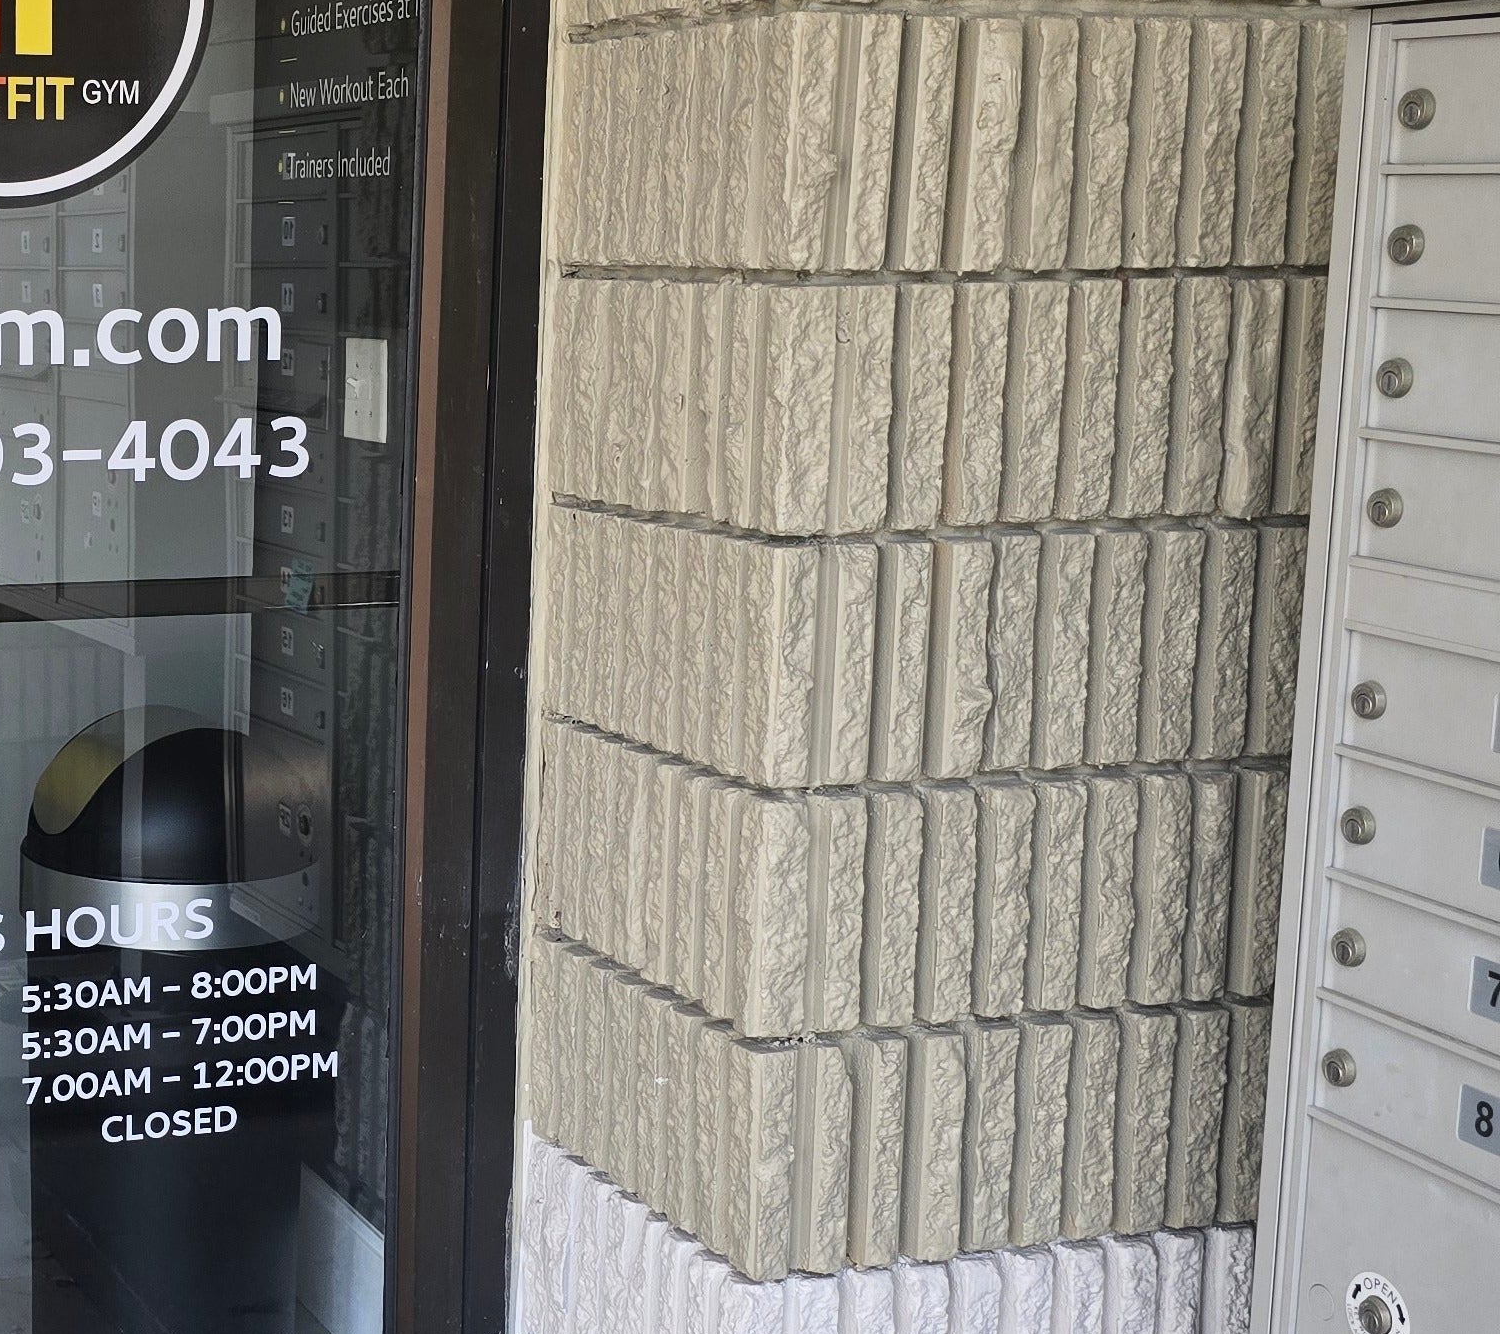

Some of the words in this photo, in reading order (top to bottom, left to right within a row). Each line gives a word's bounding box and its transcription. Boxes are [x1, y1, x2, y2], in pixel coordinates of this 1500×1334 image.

[291, 2, 332, 37] Guided
[82, 80, 140, 105] GYM
[290, 81, 317, 109] New
[319, 74, 374, 105] Workout
[378, 67, 409, 100] Each
[287, 151, 334, 180] Trainers
[337, 146, 391, 178] Included
[25, 898, 214, 952] HOURS
[22, 977, 152, 1013] 5:30AM
[190, 964, 317, 999] 8:00PM
[22, 1023, 151, 1061] 5:30AM
[191, 1010, 316, 1046] 7:00PM
[22, 1067, 152, 1105] 7.00AM
[192, 1051, 339, 1091] 12:00PM
[101, 1105, 238, 1144] CLOSED
[1474, 1100, 1494, 1138] 8
[1363, 1277, 1397, 1304] OPEN
